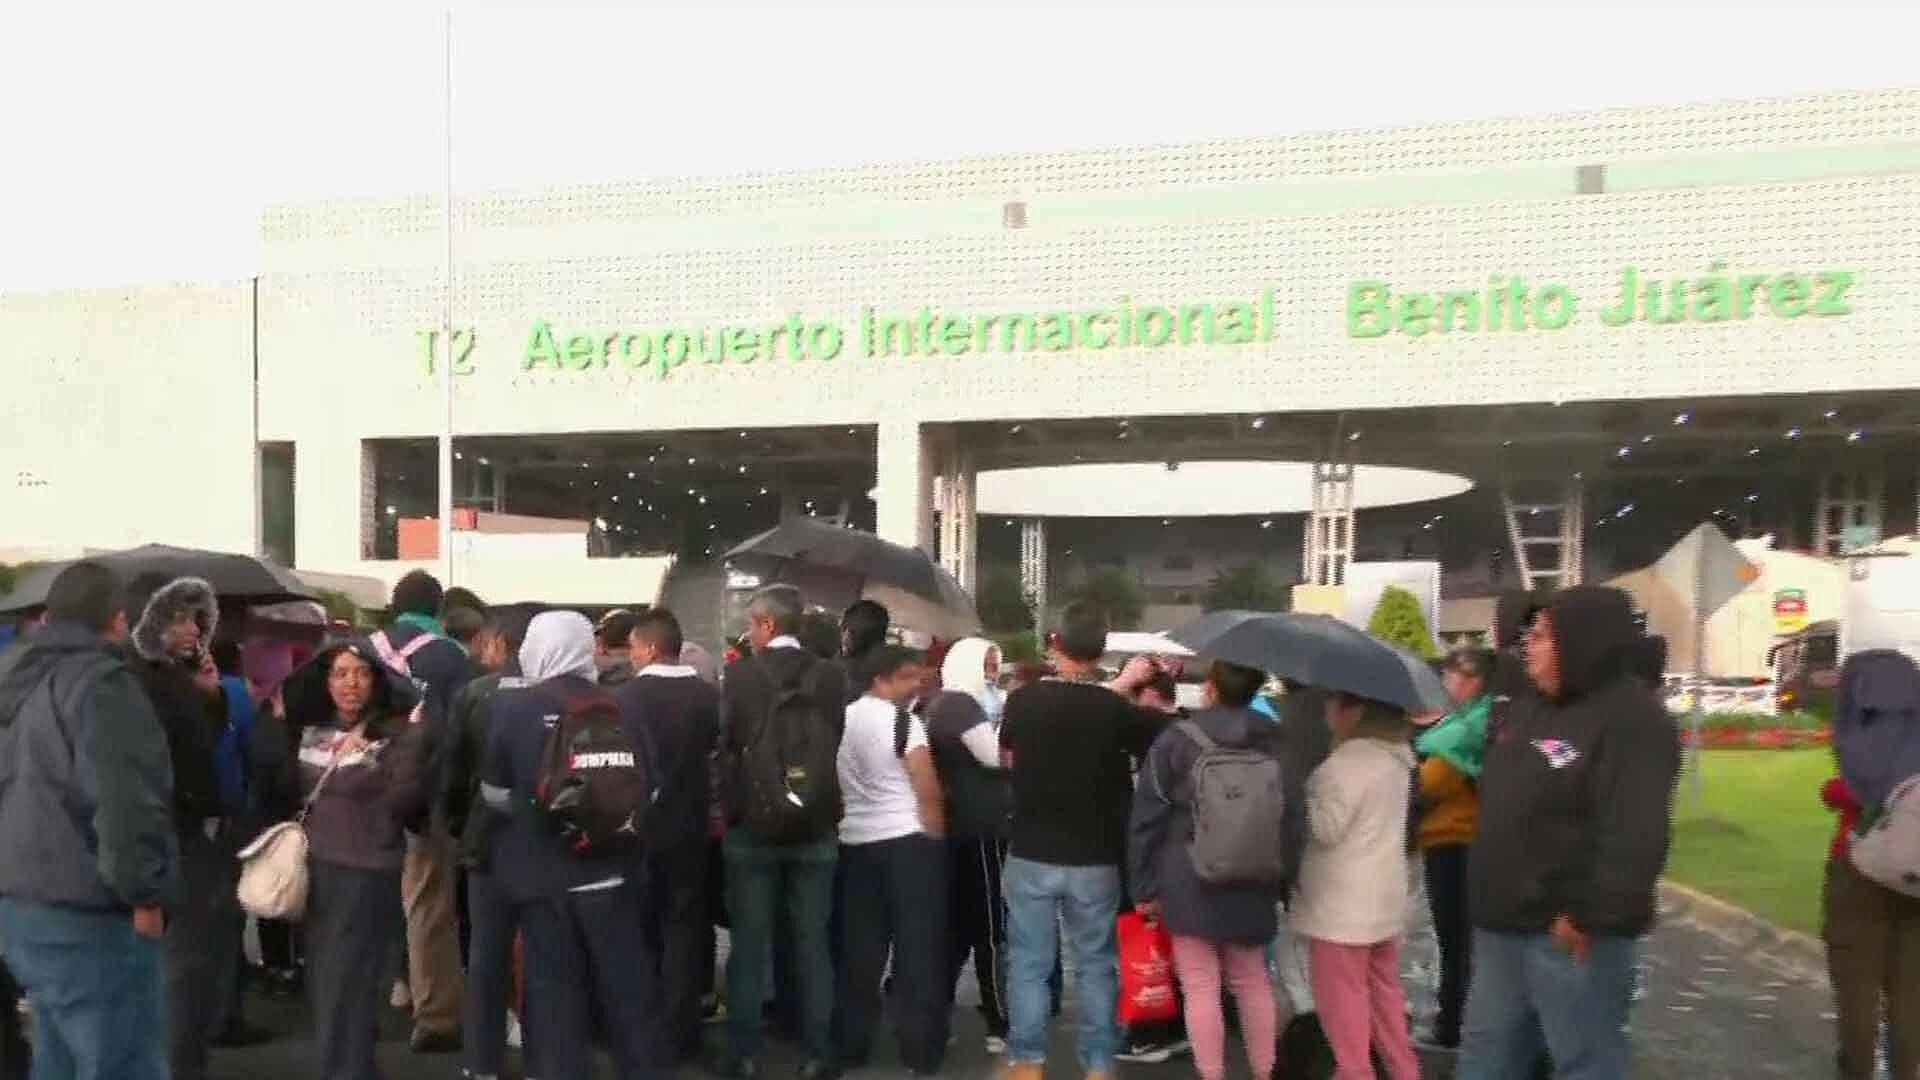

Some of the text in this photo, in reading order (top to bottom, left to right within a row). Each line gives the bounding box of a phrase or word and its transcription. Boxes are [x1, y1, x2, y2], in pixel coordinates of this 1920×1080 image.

[416, 260, 1857, 379] T2 Aeropuerto Internacional Benito Juárez
